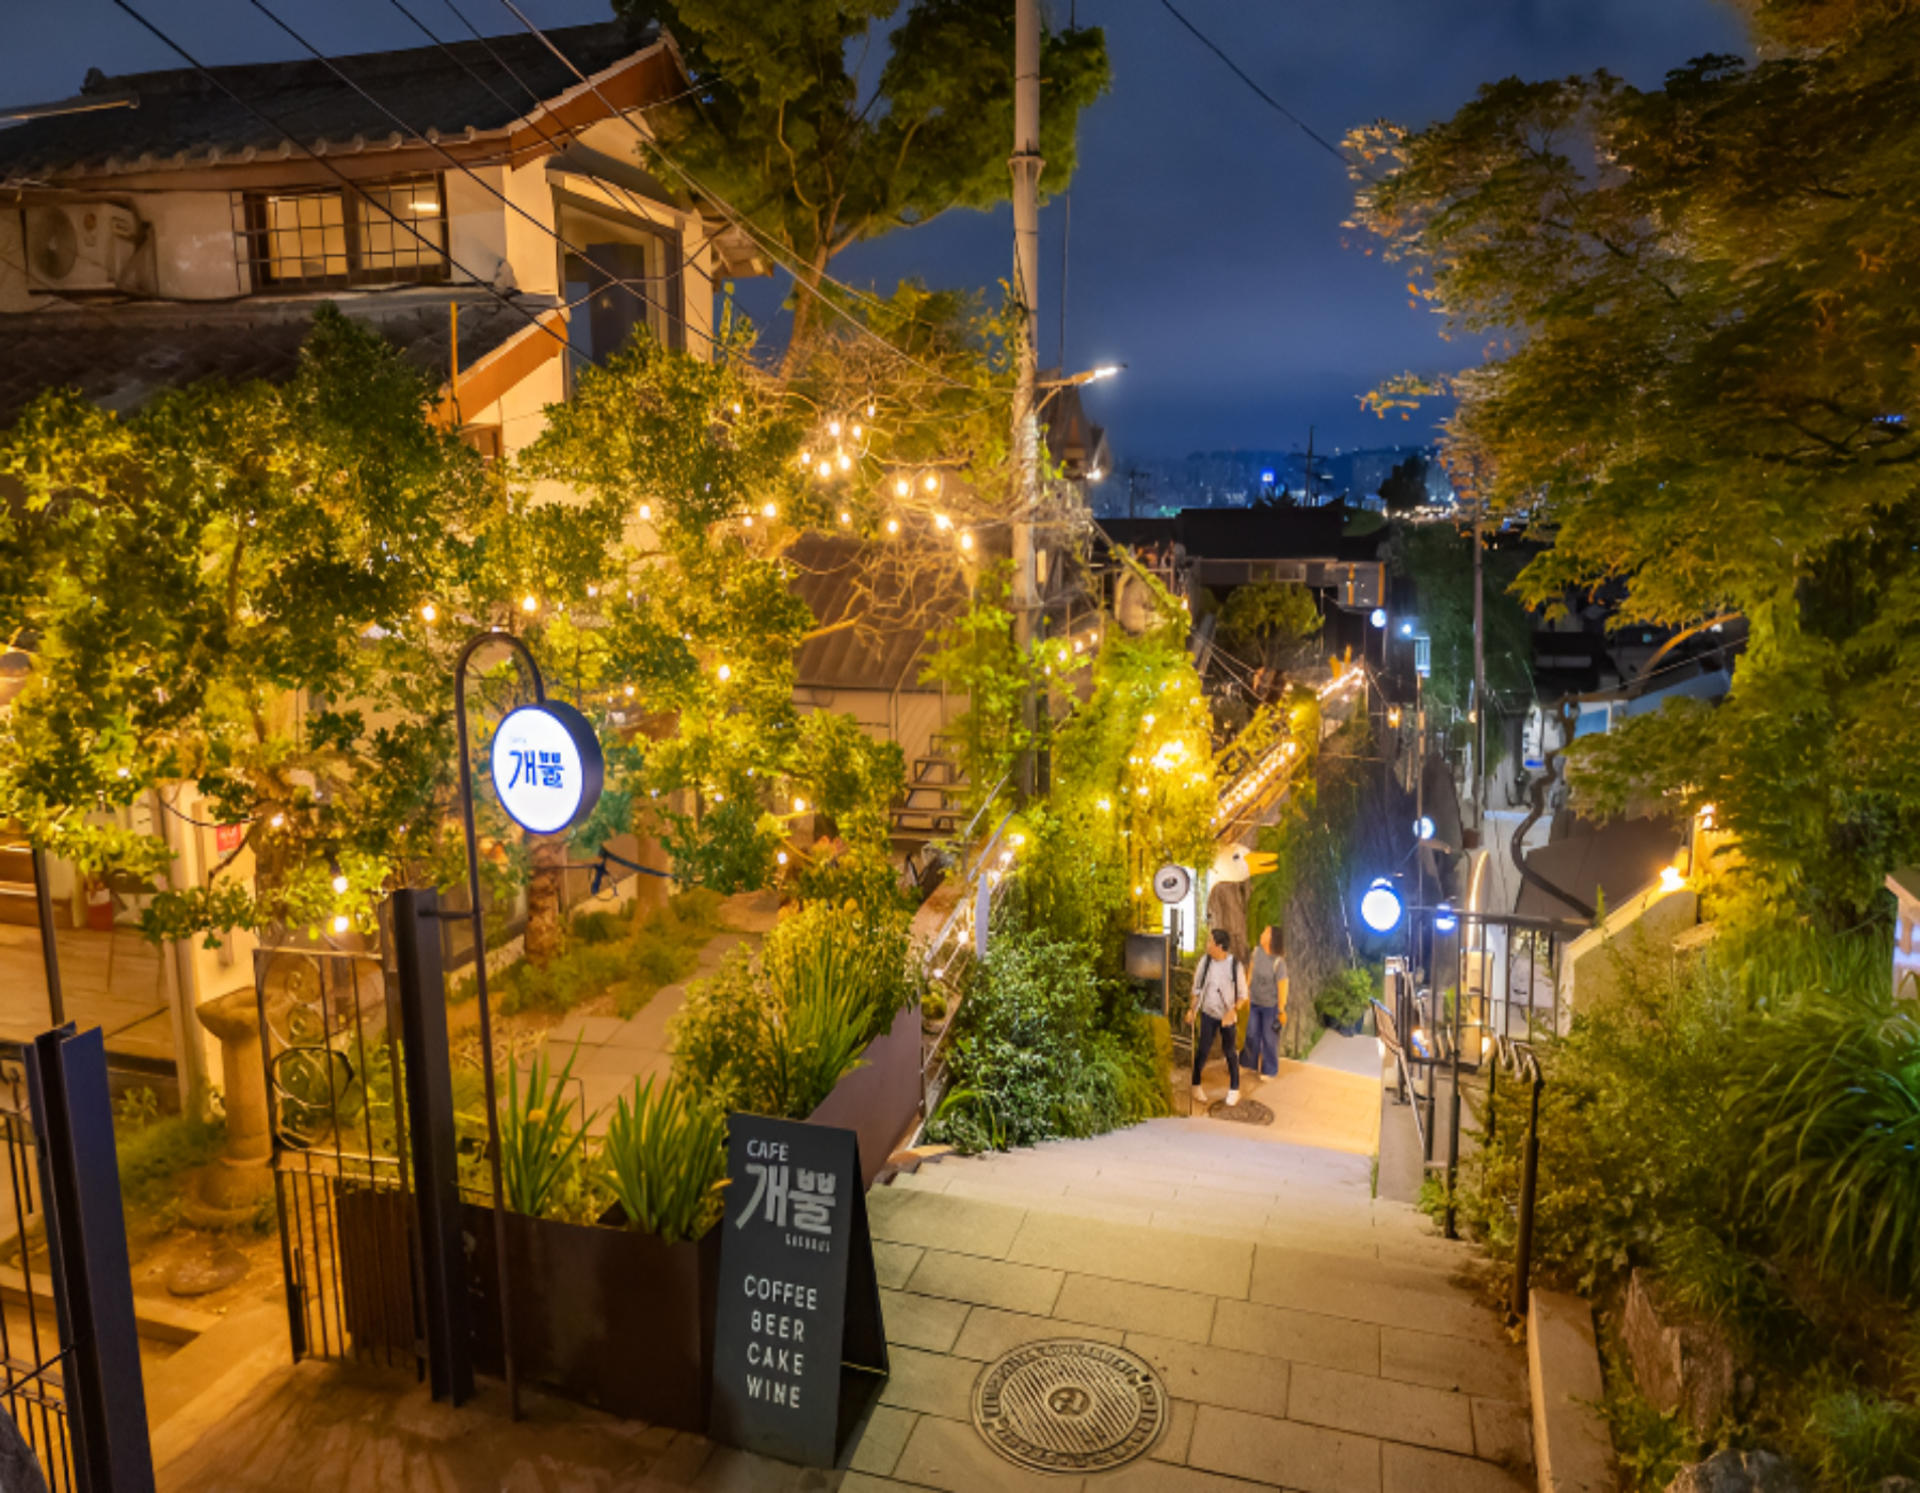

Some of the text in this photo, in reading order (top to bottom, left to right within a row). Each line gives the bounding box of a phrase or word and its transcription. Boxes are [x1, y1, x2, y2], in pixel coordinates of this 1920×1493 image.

[746, 1139, 789, 1161] CAFE
[735, 1163, 836, 1235] 개뿔
[744, 1274, 817, 1310] COFFEE
[751, 1309, 805, 1343] BEER
[747, 1342, 804, 1376] CAKE
[746, 1373, 801, 1409] WINE
